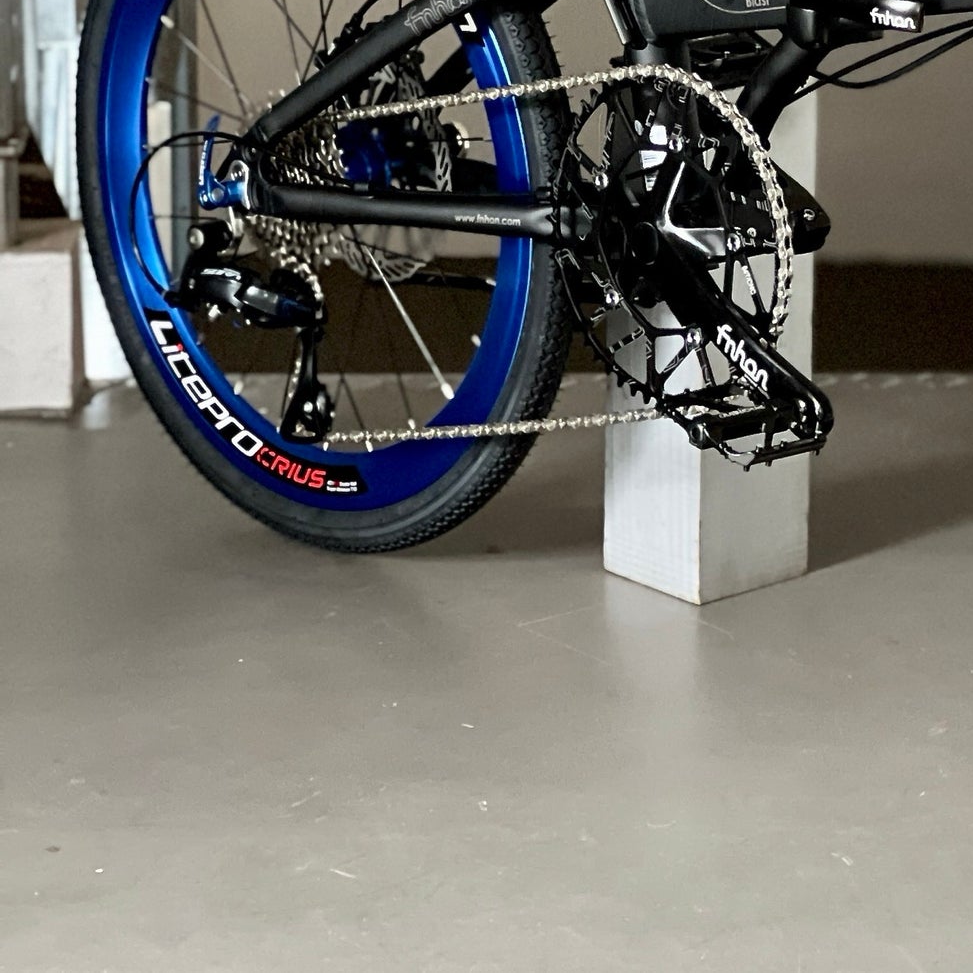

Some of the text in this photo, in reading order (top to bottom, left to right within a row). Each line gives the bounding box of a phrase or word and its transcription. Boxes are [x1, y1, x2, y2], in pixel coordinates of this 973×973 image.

[870, 8, 917, 30] fnhon
[716, 324, 769, 393] fnhon
[256, 445, 328, 489] CRIUS
